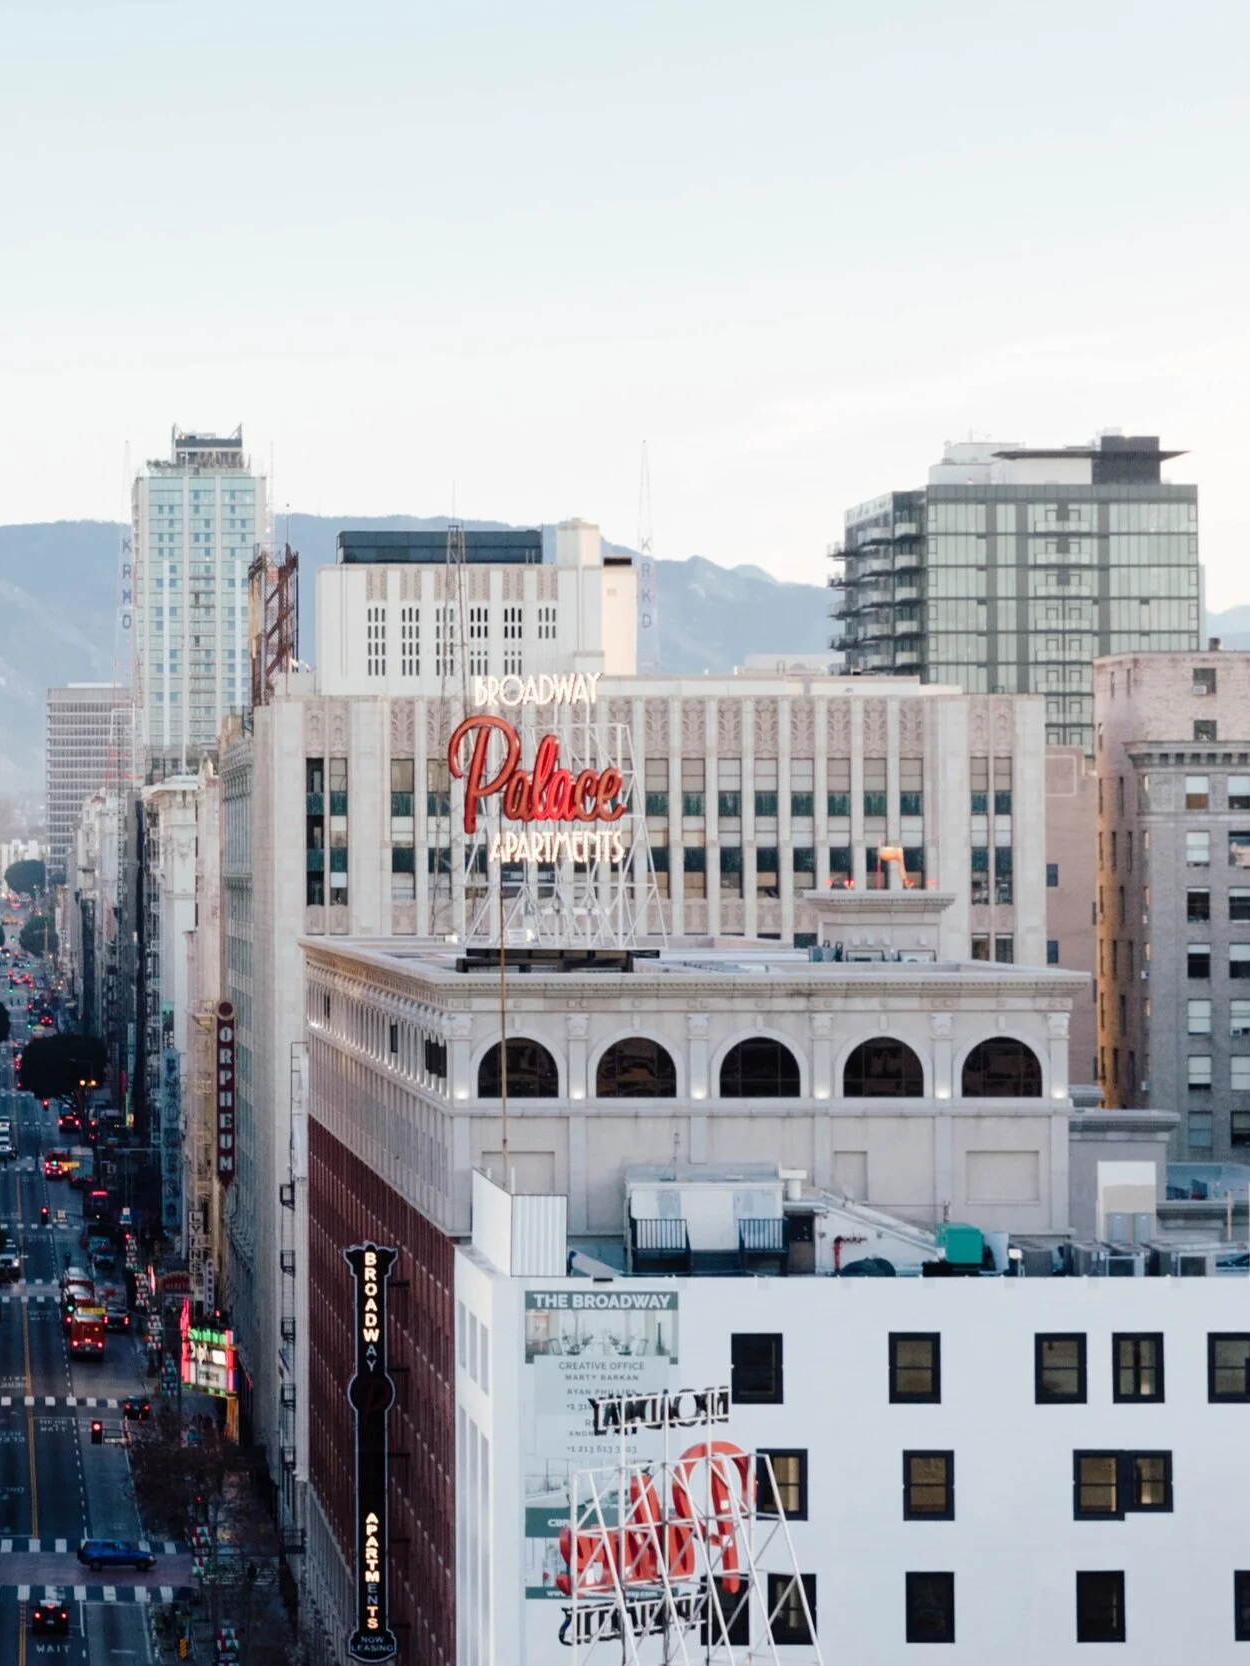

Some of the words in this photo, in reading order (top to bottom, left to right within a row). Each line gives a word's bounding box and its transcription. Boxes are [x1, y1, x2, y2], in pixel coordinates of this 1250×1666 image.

[474, 672, 601, 707] BROADWAY
[447, 714, 627, 834] Palace
[488, 831, 626, 863] APARTMENTS
[219, 1026, 233, 1171] ORPHEUM
[363, 1252, 380, 1372] BROADWAY
[533, 1293, 568, 1308] THE
[572, 1293, 671, 1309] BROADWAY
[558, 1361, 607, 1370] CREATIVE
[609, 1361, 645, 1370] OFFICE
[615, 1445, 637, 1453] 303
[365, 1512, 380, 1629] APARTMENTS
[35, 1644, 71, 1653] WAIT
[351, 1643, 394, 1651] LEASING
